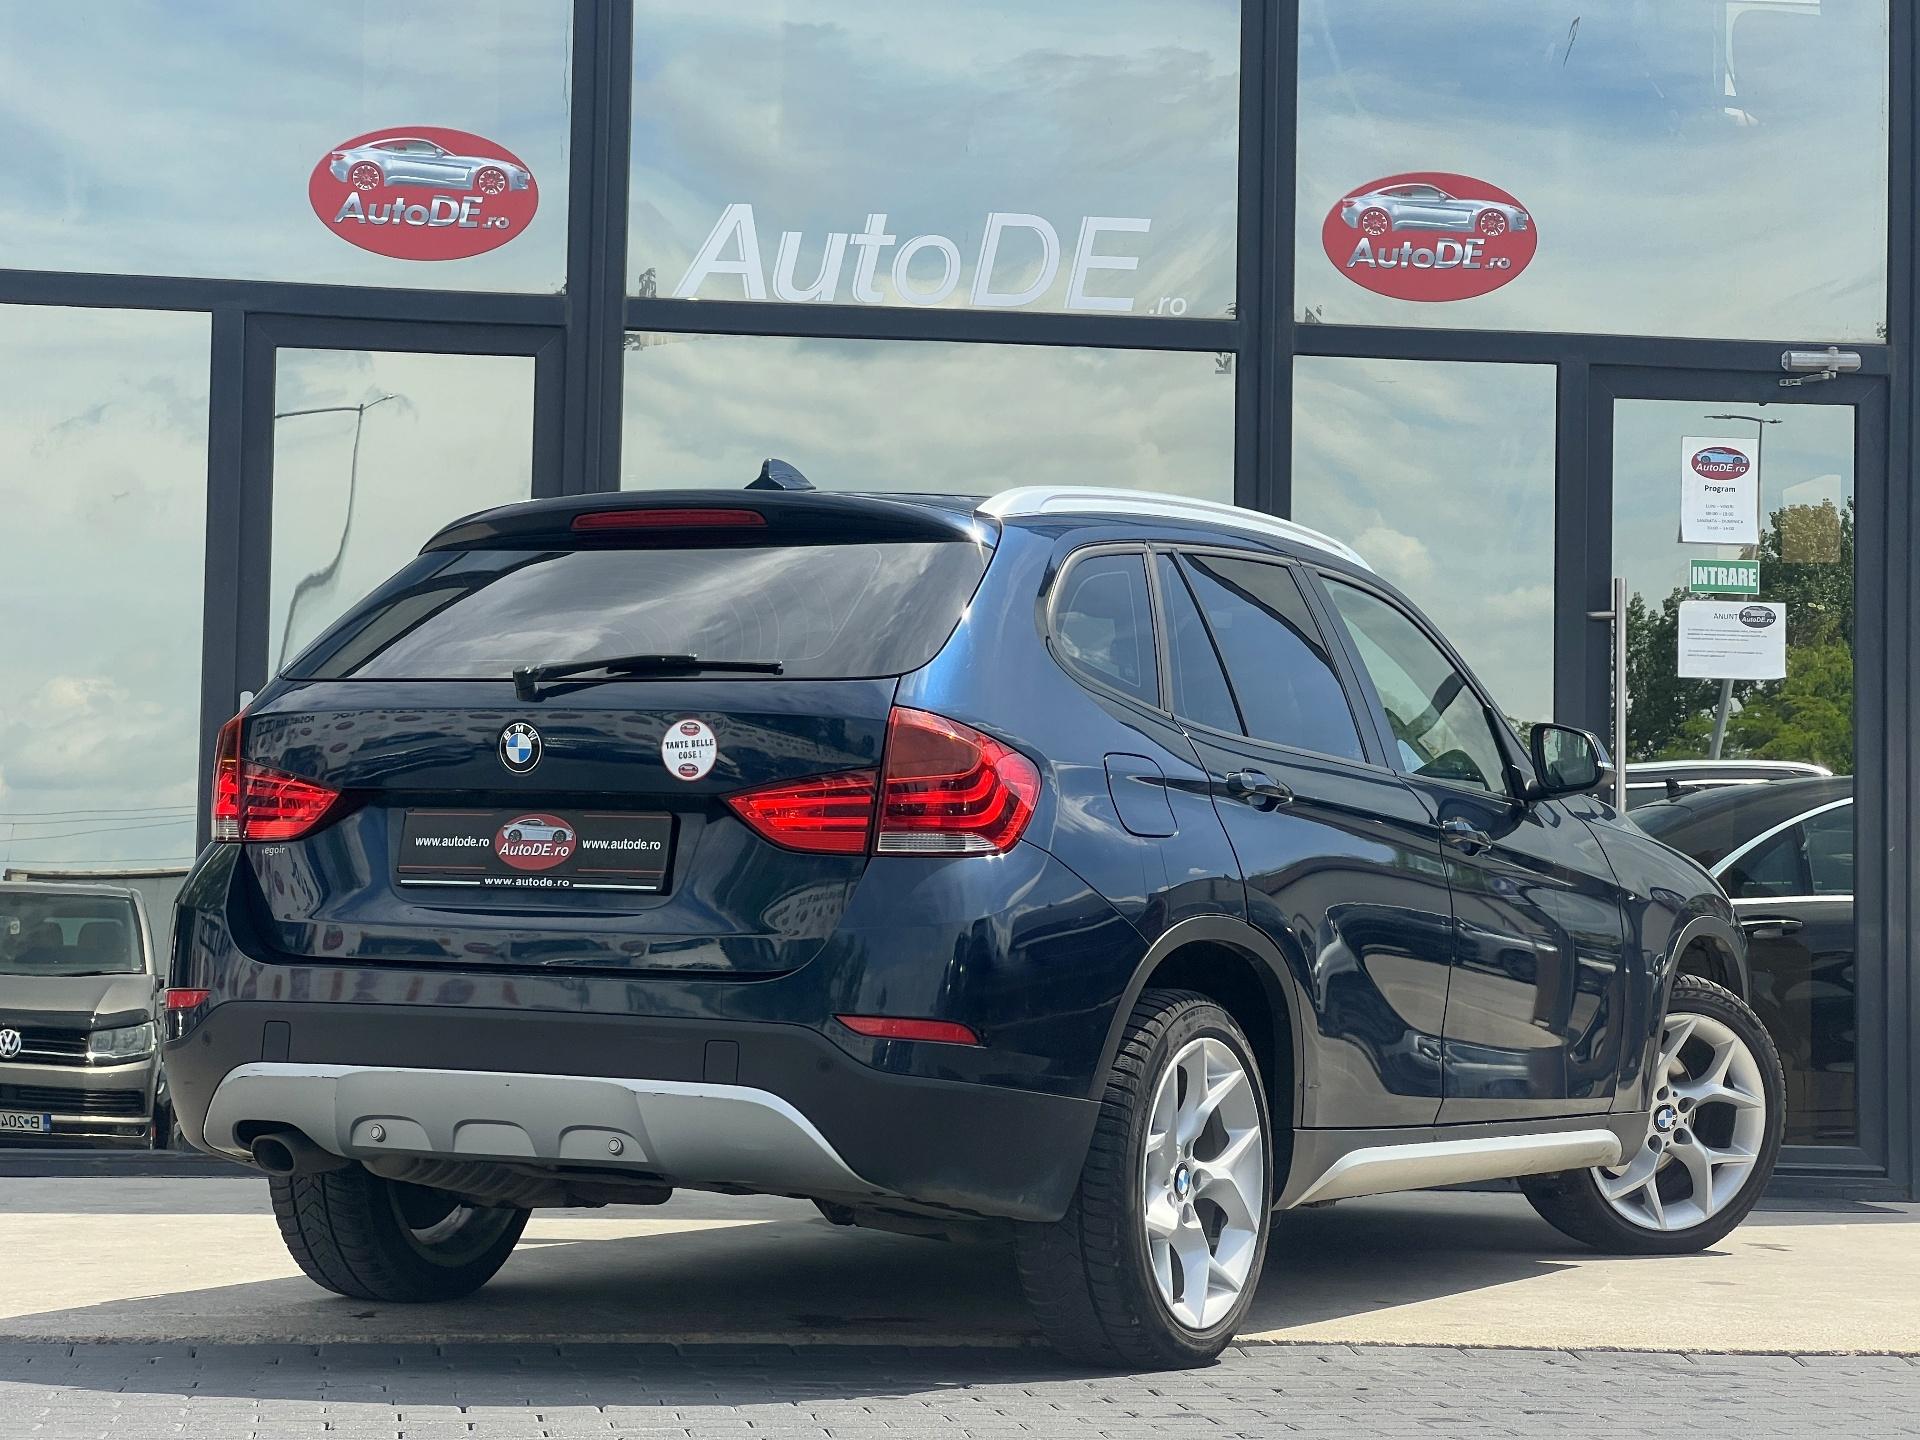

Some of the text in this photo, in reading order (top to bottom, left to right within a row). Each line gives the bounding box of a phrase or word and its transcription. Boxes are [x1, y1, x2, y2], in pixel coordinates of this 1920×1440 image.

[1696, 463, 1746, 473] AutoDE.ro
[1704, 485, 1736, 494] Program
[1692, 565, 1757, 587] INTRARE
[503, 724, 538, 741] BMW
[665, 738, 714, 749] TANTE BELLE
[678, 751, 698, 760] COSE
[415, 836, 662, 857] www.autode.ro AutoDE.ro www.autode.ro
[484, 876, 570, 887] www.autode.ro
